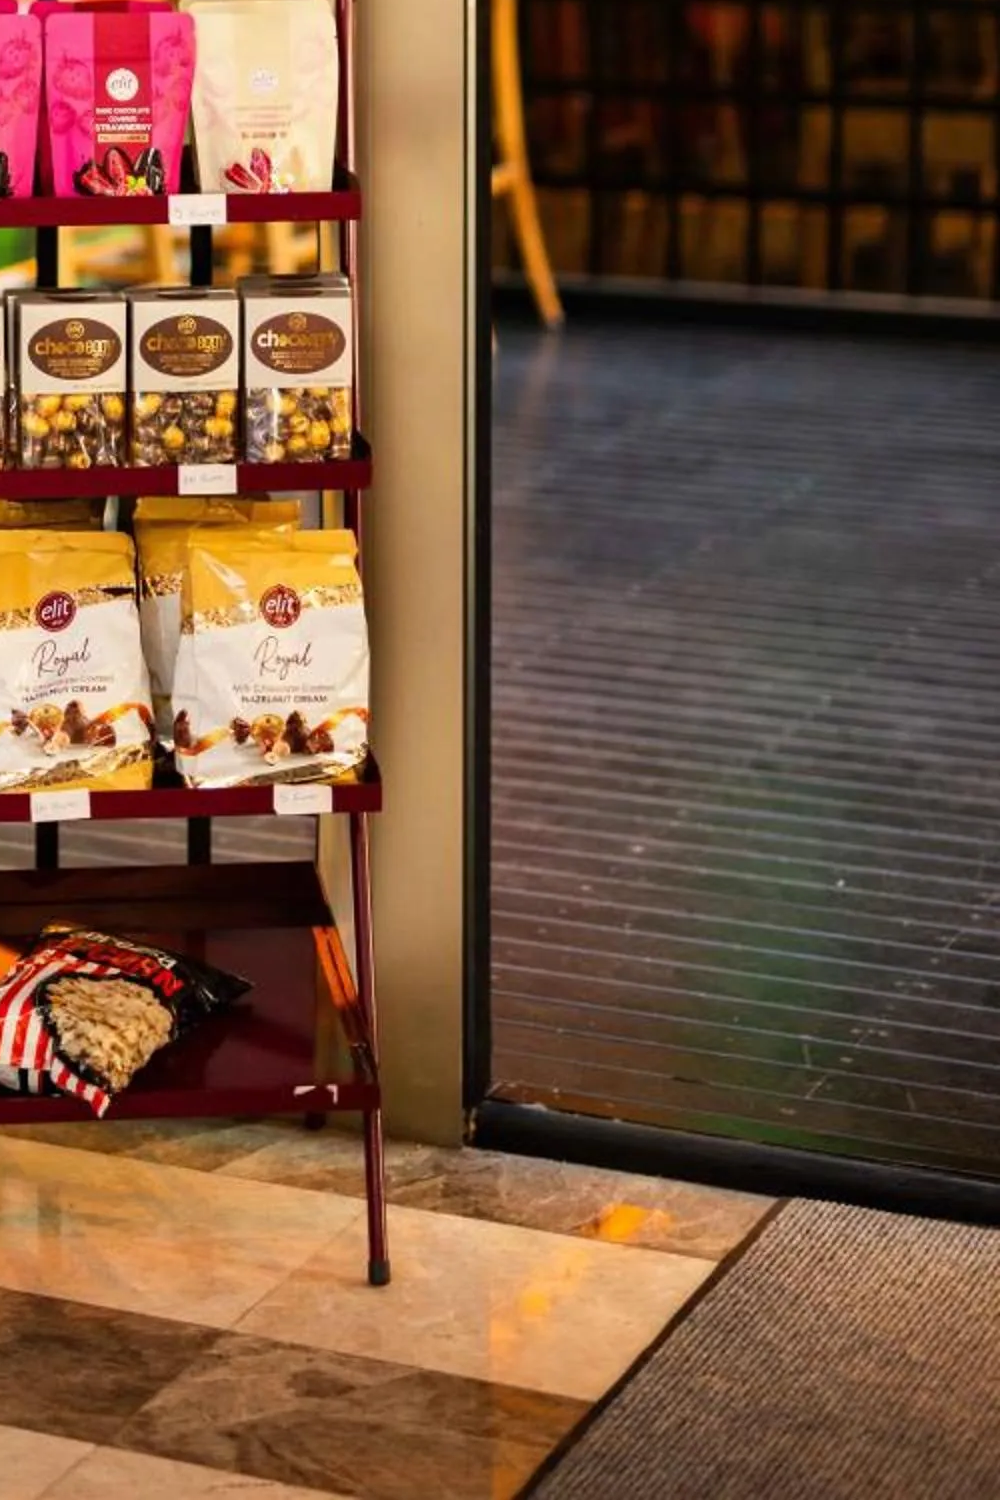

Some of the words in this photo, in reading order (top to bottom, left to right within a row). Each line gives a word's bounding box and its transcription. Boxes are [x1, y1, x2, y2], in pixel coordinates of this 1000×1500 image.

[41, 597, 69, 620] elit
[266, 593, 295, 614] elit
[31, 638, 93, 678] Royal
[253, 635, 314, 680] Royal
